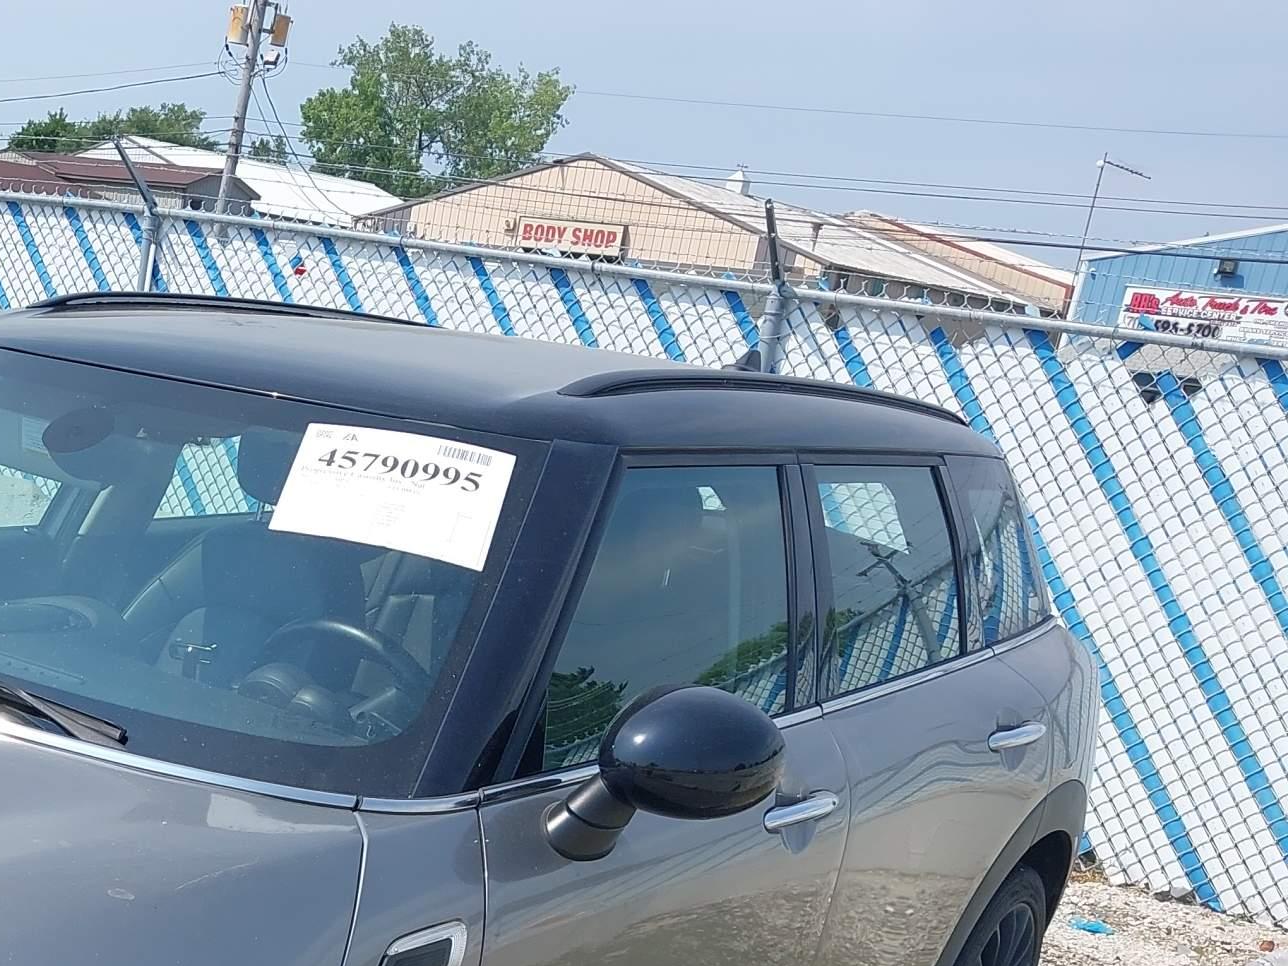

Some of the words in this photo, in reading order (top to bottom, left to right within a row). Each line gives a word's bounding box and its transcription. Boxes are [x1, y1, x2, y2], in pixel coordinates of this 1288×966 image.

[522, 223, 567, 244] BODY
[571, 227, 618, 249] SHOP
[1160, 306, 1199, 318] SERVICE
[1200, 310, 1237, 321] CENTER
[317, 448, 484, 493] 45790995
